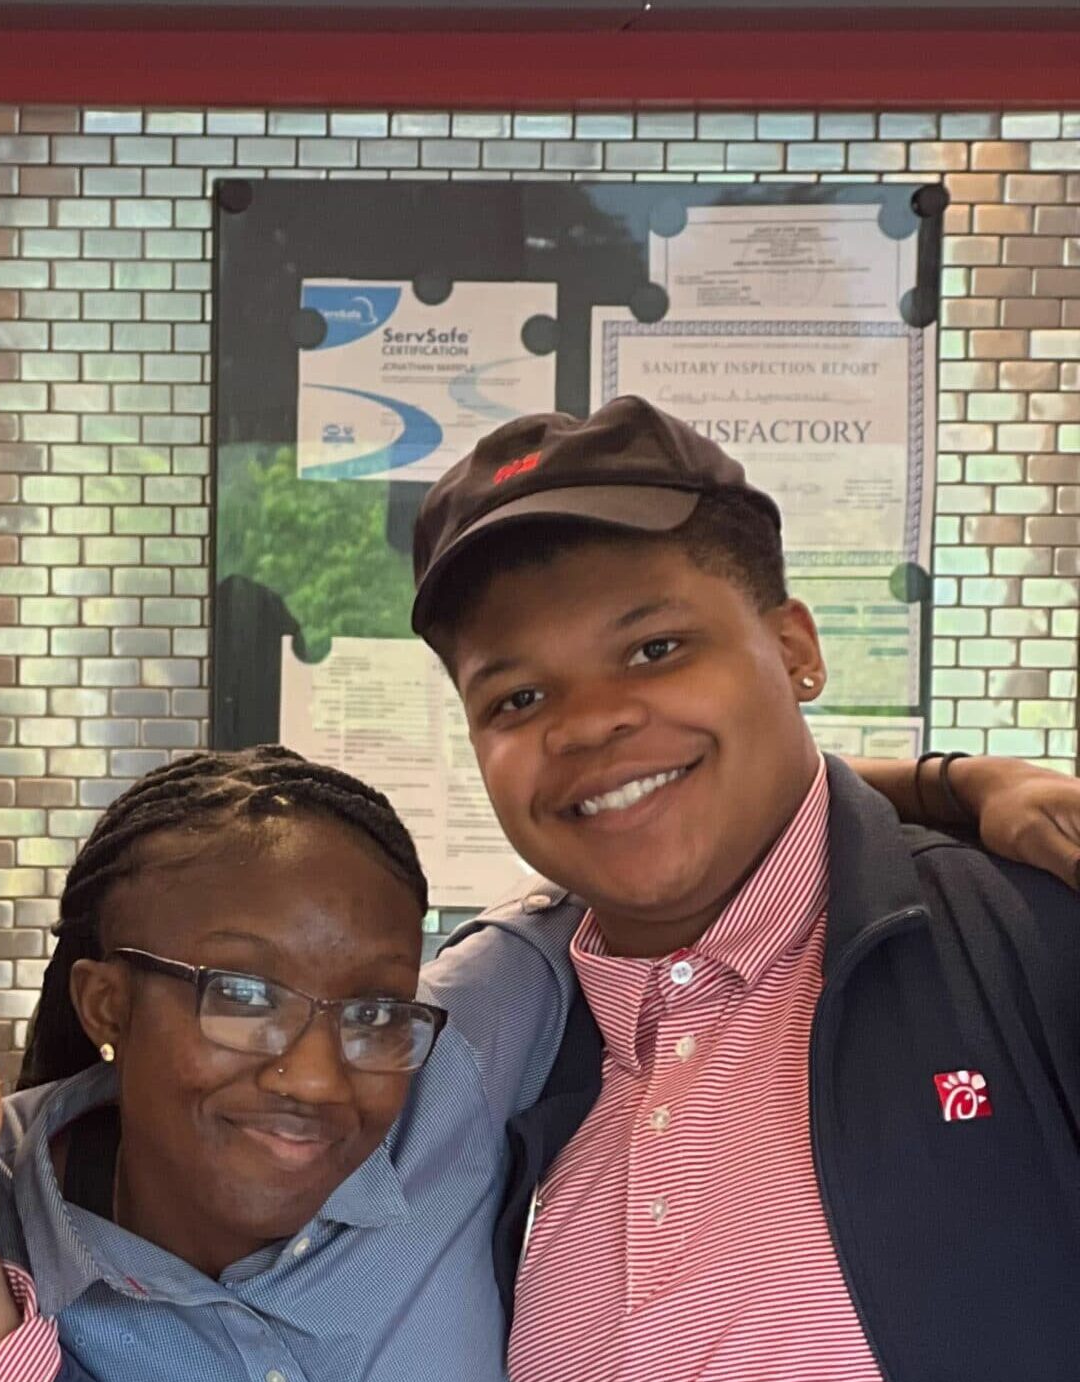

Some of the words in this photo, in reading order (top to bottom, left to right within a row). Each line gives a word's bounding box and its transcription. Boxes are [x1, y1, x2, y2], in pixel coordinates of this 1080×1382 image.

[383, 327, 468, 344] ServSafe
[381, 346, 469, 356] CERTIFICATION
[642, 362, 718, 375] SANITARY
[724, 362, 815, 375] INSPECTION
[822, 362, 880, 376] REPORT
